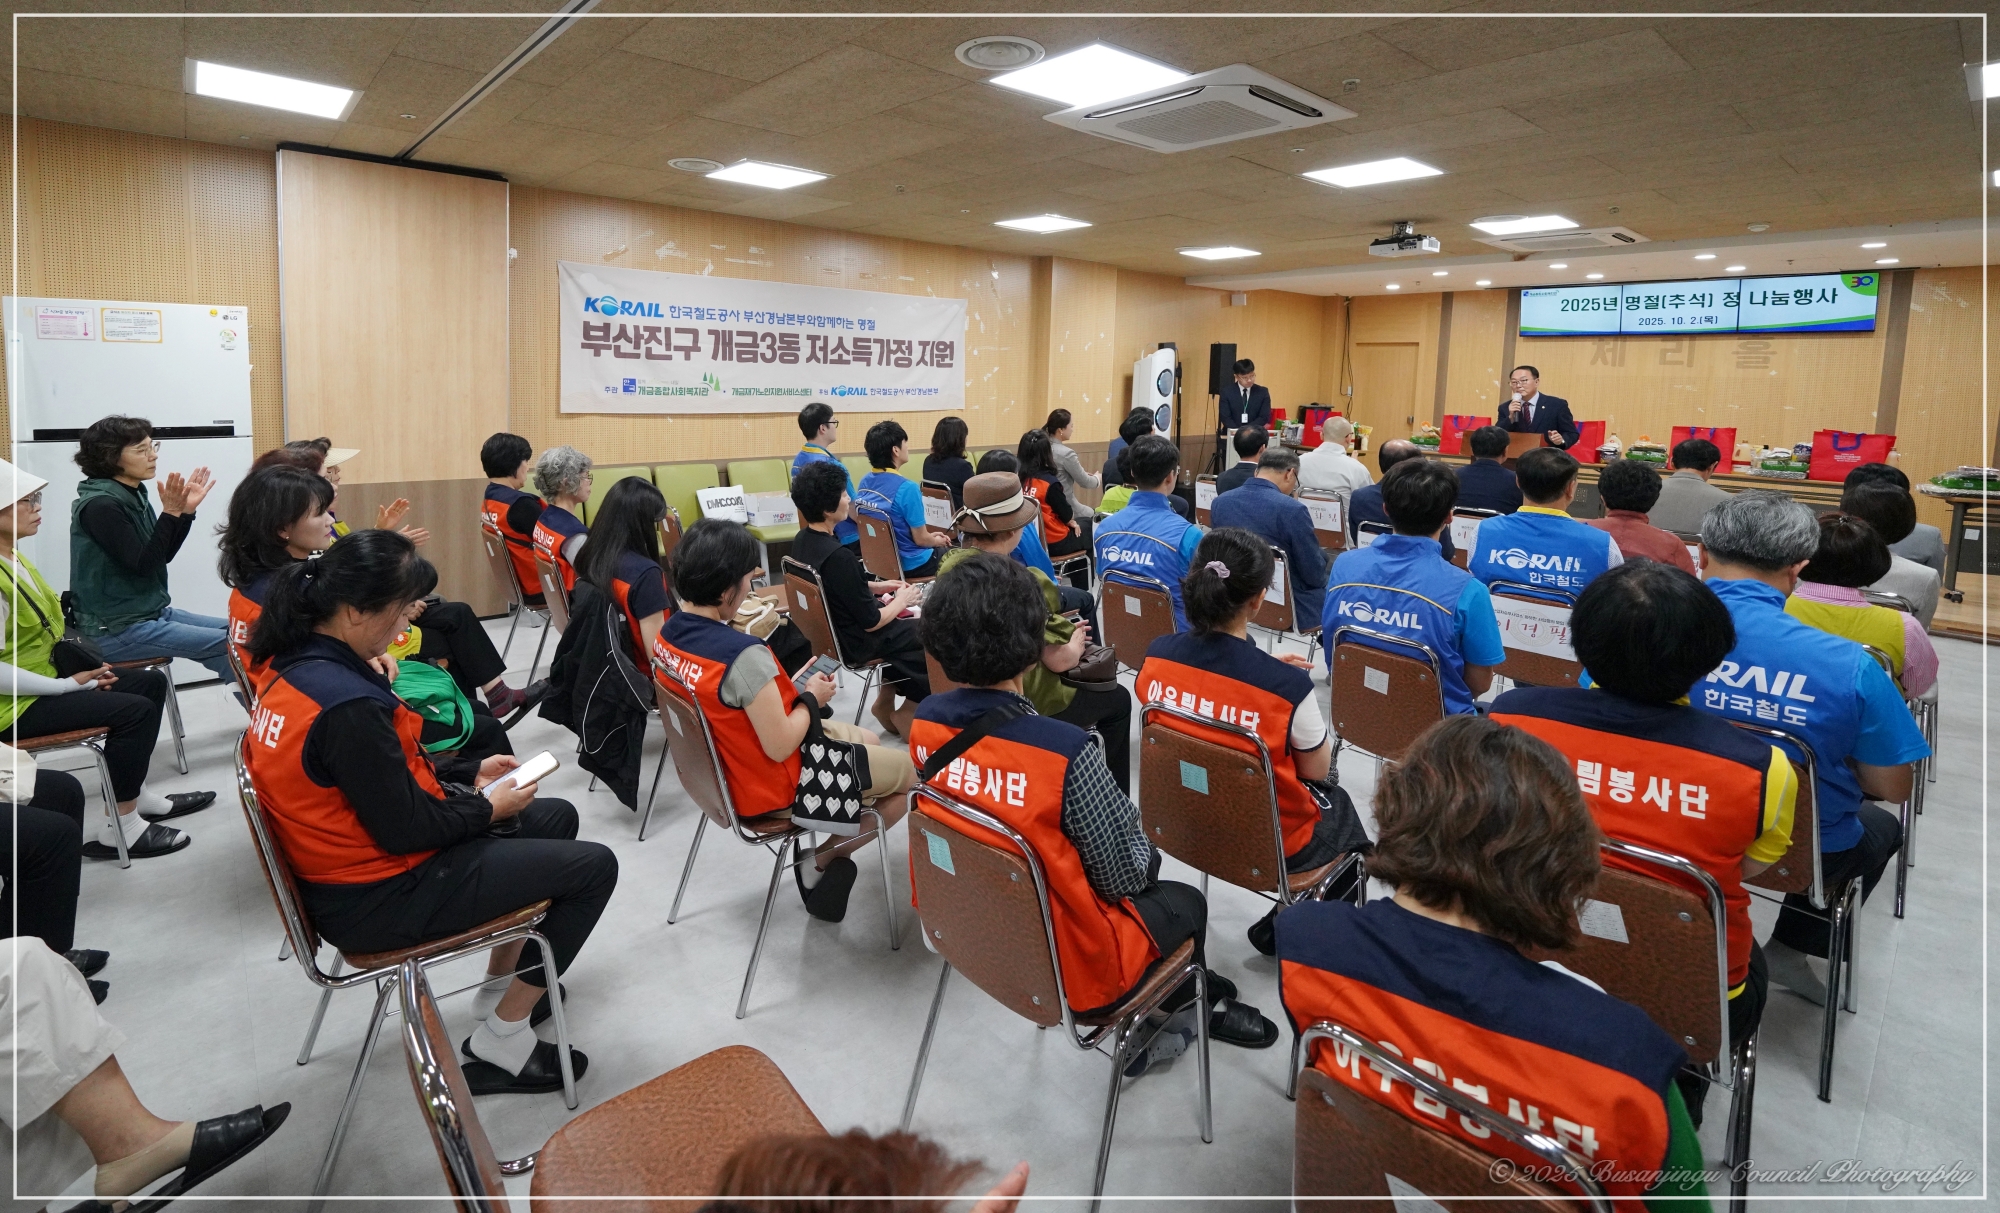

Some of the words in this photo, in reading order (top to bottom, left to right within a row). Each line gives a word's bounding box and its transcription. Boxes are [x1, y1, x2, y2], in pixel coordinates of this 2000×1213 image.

[584, 295, 664, 318] KORAIL
[1561, 296, 1618, 312] 2025년
[1625, 293, 1714, 311] 명절(추석)
[1722, 291, 1740, 308] 정
[1750, 287, 1838, 306] 나눔행사
[669, 305, 741, 322] 한국철도공사
[744, 310, 854, 330] 부산경남본부와함께하는
[857, 318, 876, 331] 명절
[1638, 317, 1666, 326] 2025.
[1671, 316, 1686, 325] 10.
[1690, 315, 1718, 326] 2.(목)
[581, 320, 701, 362] 부산진구
[708, 328, 801, 365] 개금3동
[806, 333, 913, 369] 저소득가정
[915, 339, 955, 369] 지원
[638, 386, 709, 396] 개금종합사회복지관
[830, 385, 868, 397] KORAIL
[870, 388, 905, 396] 한국철도공사
[1102, 546, 1154, 566] KORAIL
[1488, 548, 1587, 573] KORAIL
[1529, 572, 1585, 587] 한국철도
[1338, 600, 1422, 630] KORAIL
[1705, 660, 1815, 702] RAIL
[1704, 689, 1807, 726] 한국철도
[1576, 759, 1710, 820] 림봉사단
